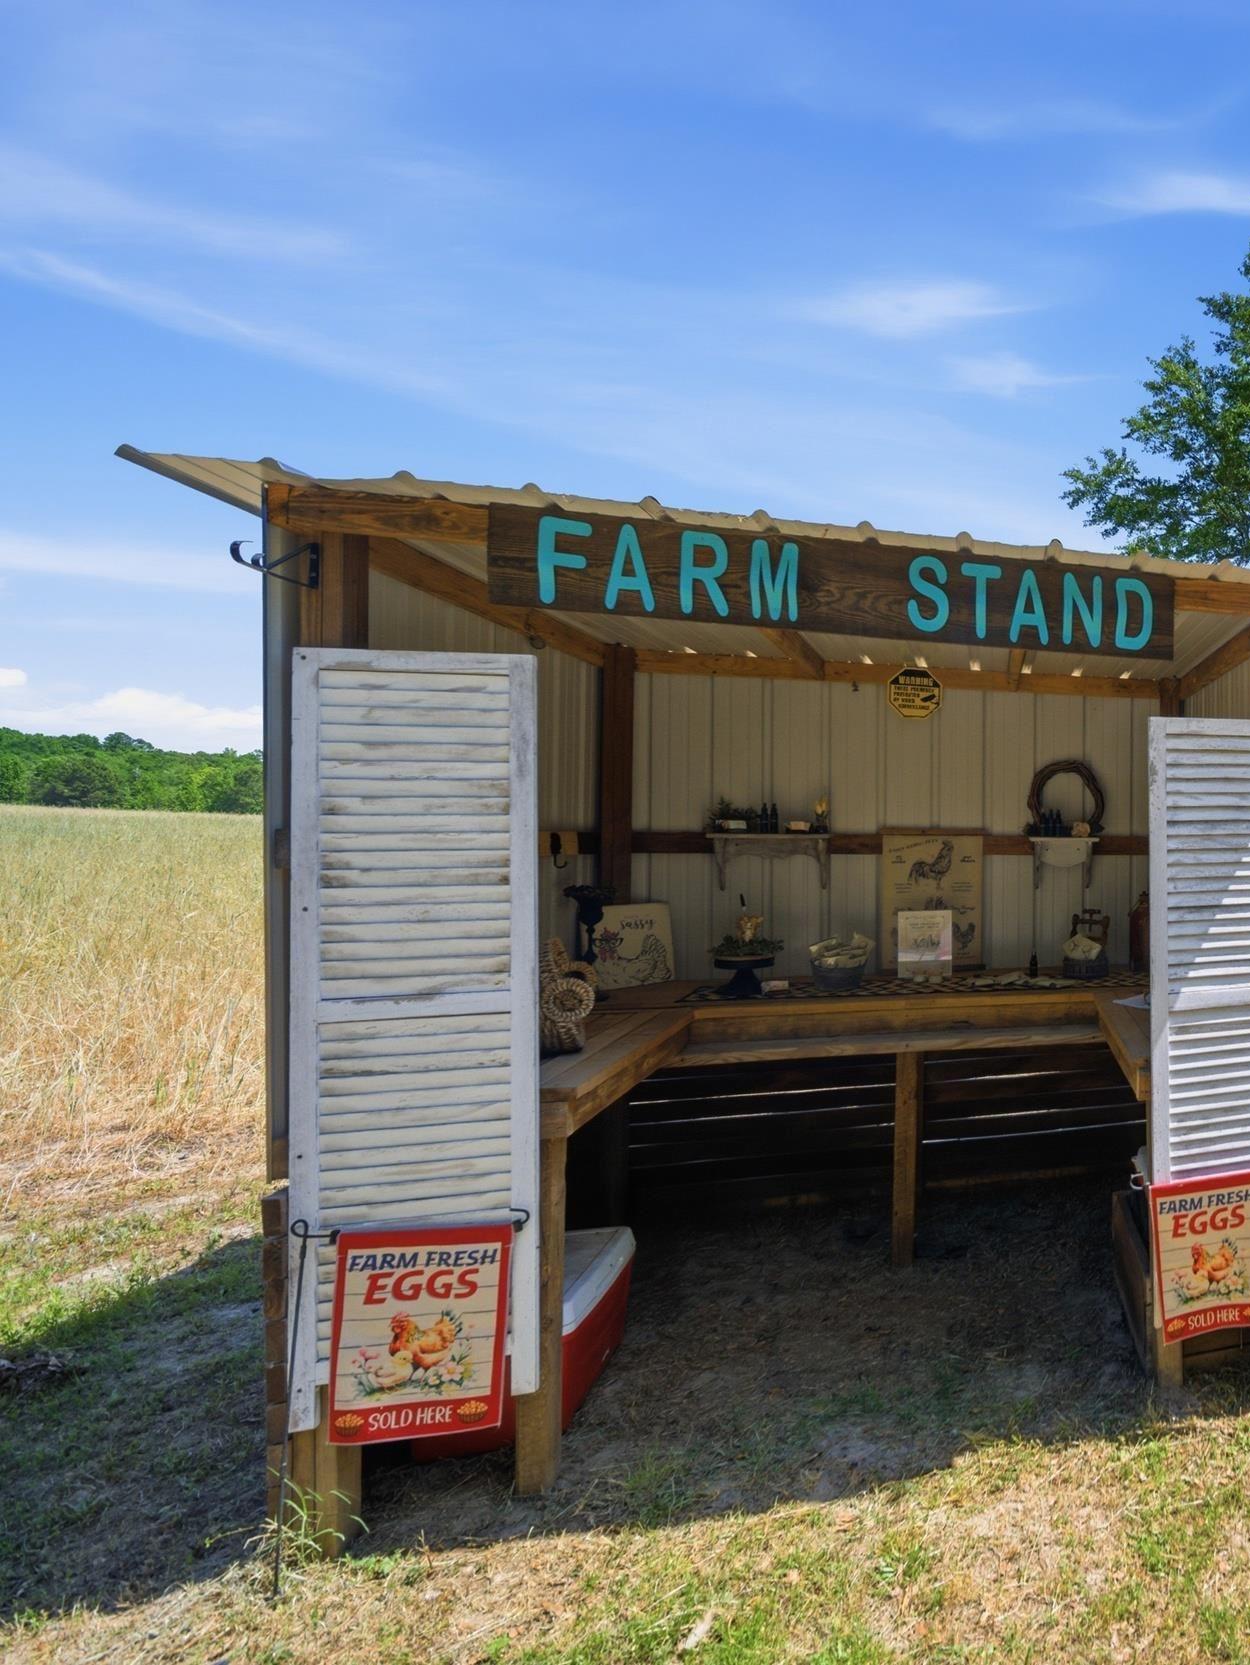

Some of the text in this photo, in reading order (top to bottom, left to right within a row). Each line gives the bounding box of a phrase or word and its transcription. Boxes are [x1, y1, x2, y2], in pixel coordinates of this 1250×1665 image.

[537, 515, 1153, 651] FARM STAND
[1159, 1197, 1203, 1215] FARM
[1171, 1204, 1245, 1239] EGGS
[347, 1248, 498, 1273] FARM FRESH
[362, 1268, 480, 1306] EGGS
[1187, 1308, 1241, 1331] SOLD HERE
[367, 1405, 455, 1432] SOLD HERE
